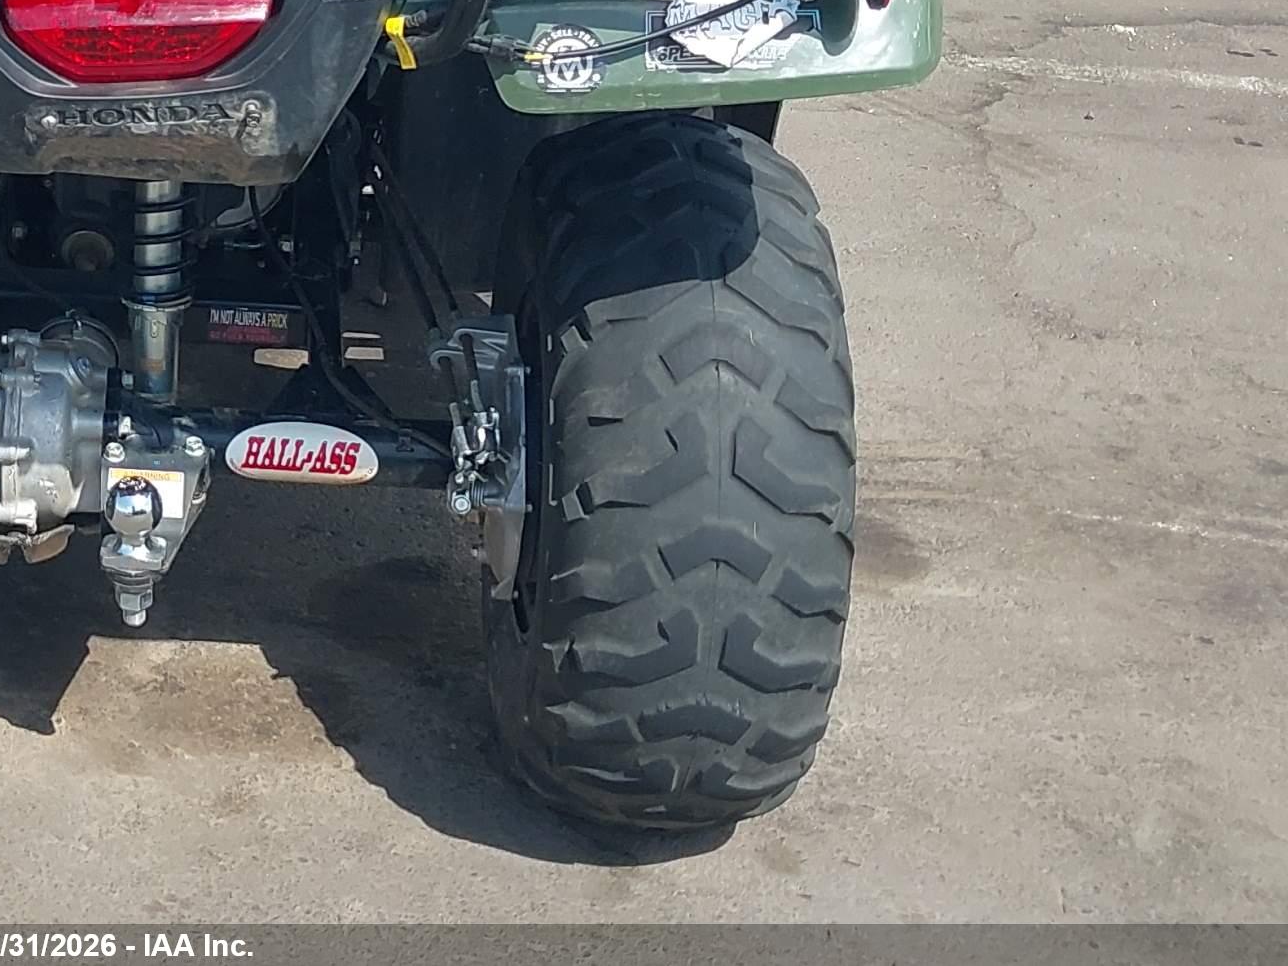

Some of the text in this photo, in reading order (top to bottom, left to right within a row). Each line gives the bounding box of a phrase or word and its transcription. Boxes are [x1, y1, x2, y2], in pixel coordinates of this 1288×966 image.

[56, 104, 234, 126] HONDA
[220, 309, 234, 325] NOT
[267, 313, 288, 329] PRICK
